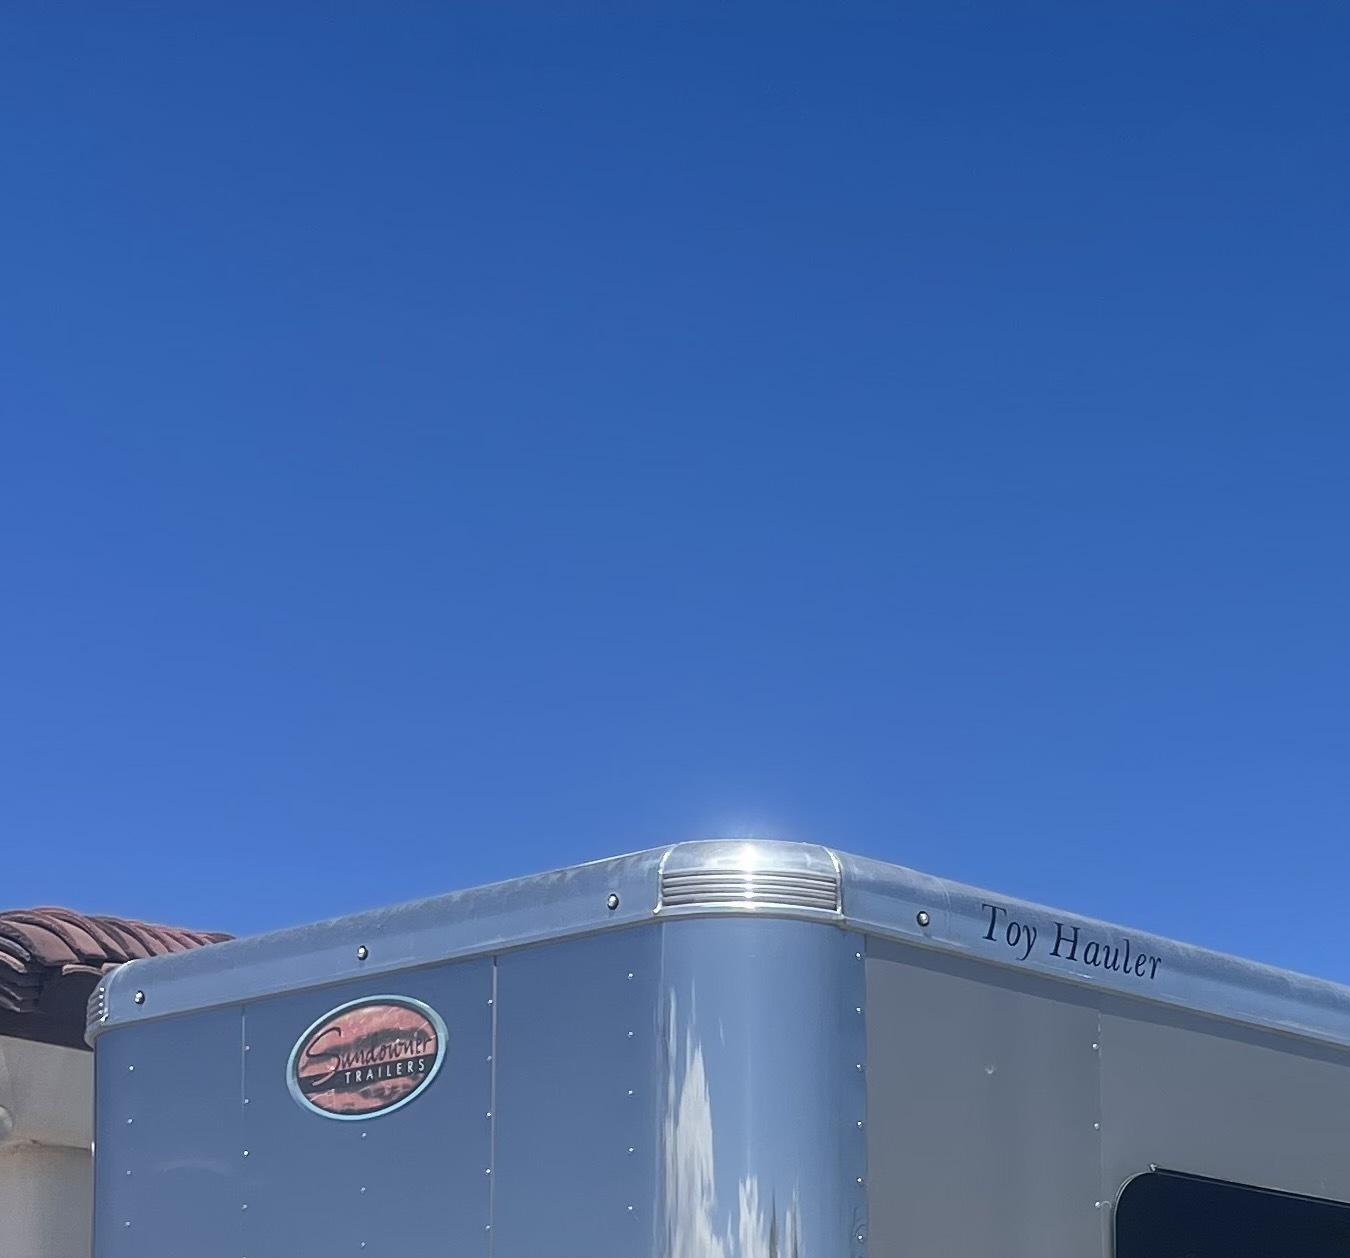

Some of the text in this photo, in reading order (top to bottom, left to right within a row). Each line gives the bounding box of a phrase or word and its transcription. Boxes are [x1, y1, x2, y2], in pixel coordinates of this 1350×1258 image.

[981, 903, 1162, 980] Toy Hauler
[305, 1026, 433, 1087] Sundowner
[344, 1058, 425, 1084] TRAILERS
